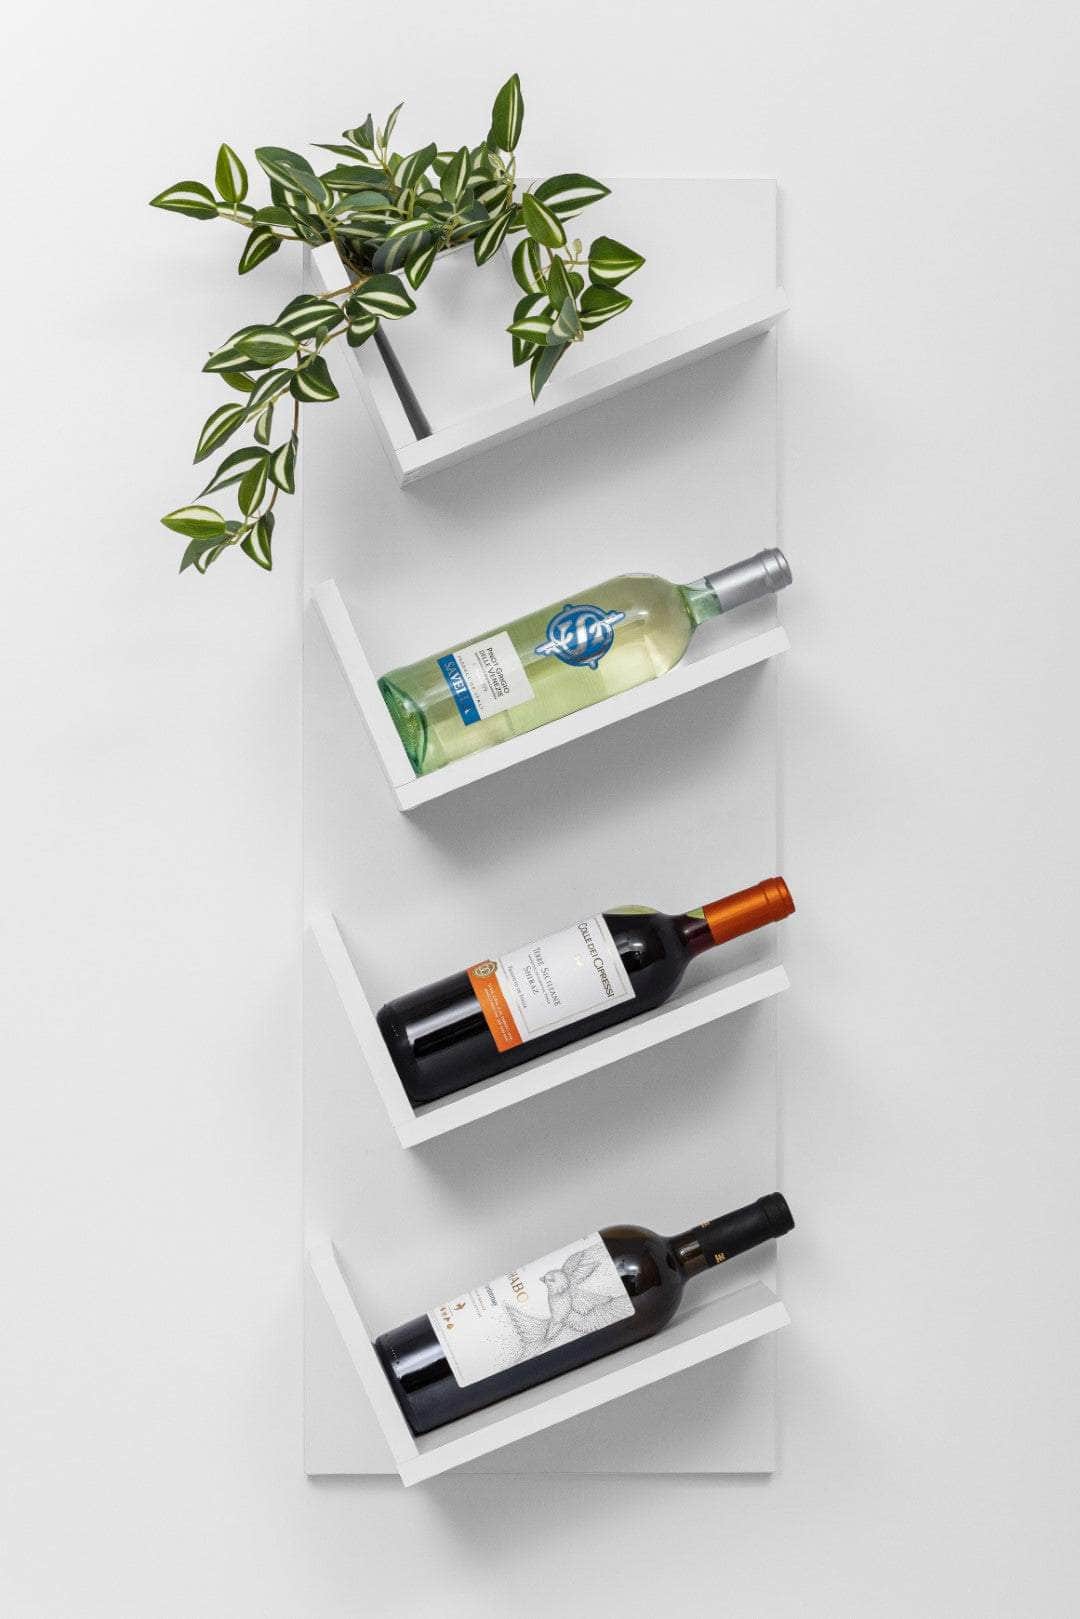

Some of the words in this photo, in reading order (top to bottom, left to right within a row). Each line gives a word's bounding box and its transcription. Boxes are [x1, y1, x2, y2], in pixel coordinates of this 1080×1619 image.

[479, 650, 491, 667] DELLE
[486, 647, 498, 665] PINOT
[495, 668, 510, 694] GRIGIO
[577, 922, 593, 943] COLLE
[593, 956, 615, 998] CIPRESSI
[524, 966, 539, 995] SHIRAZ
